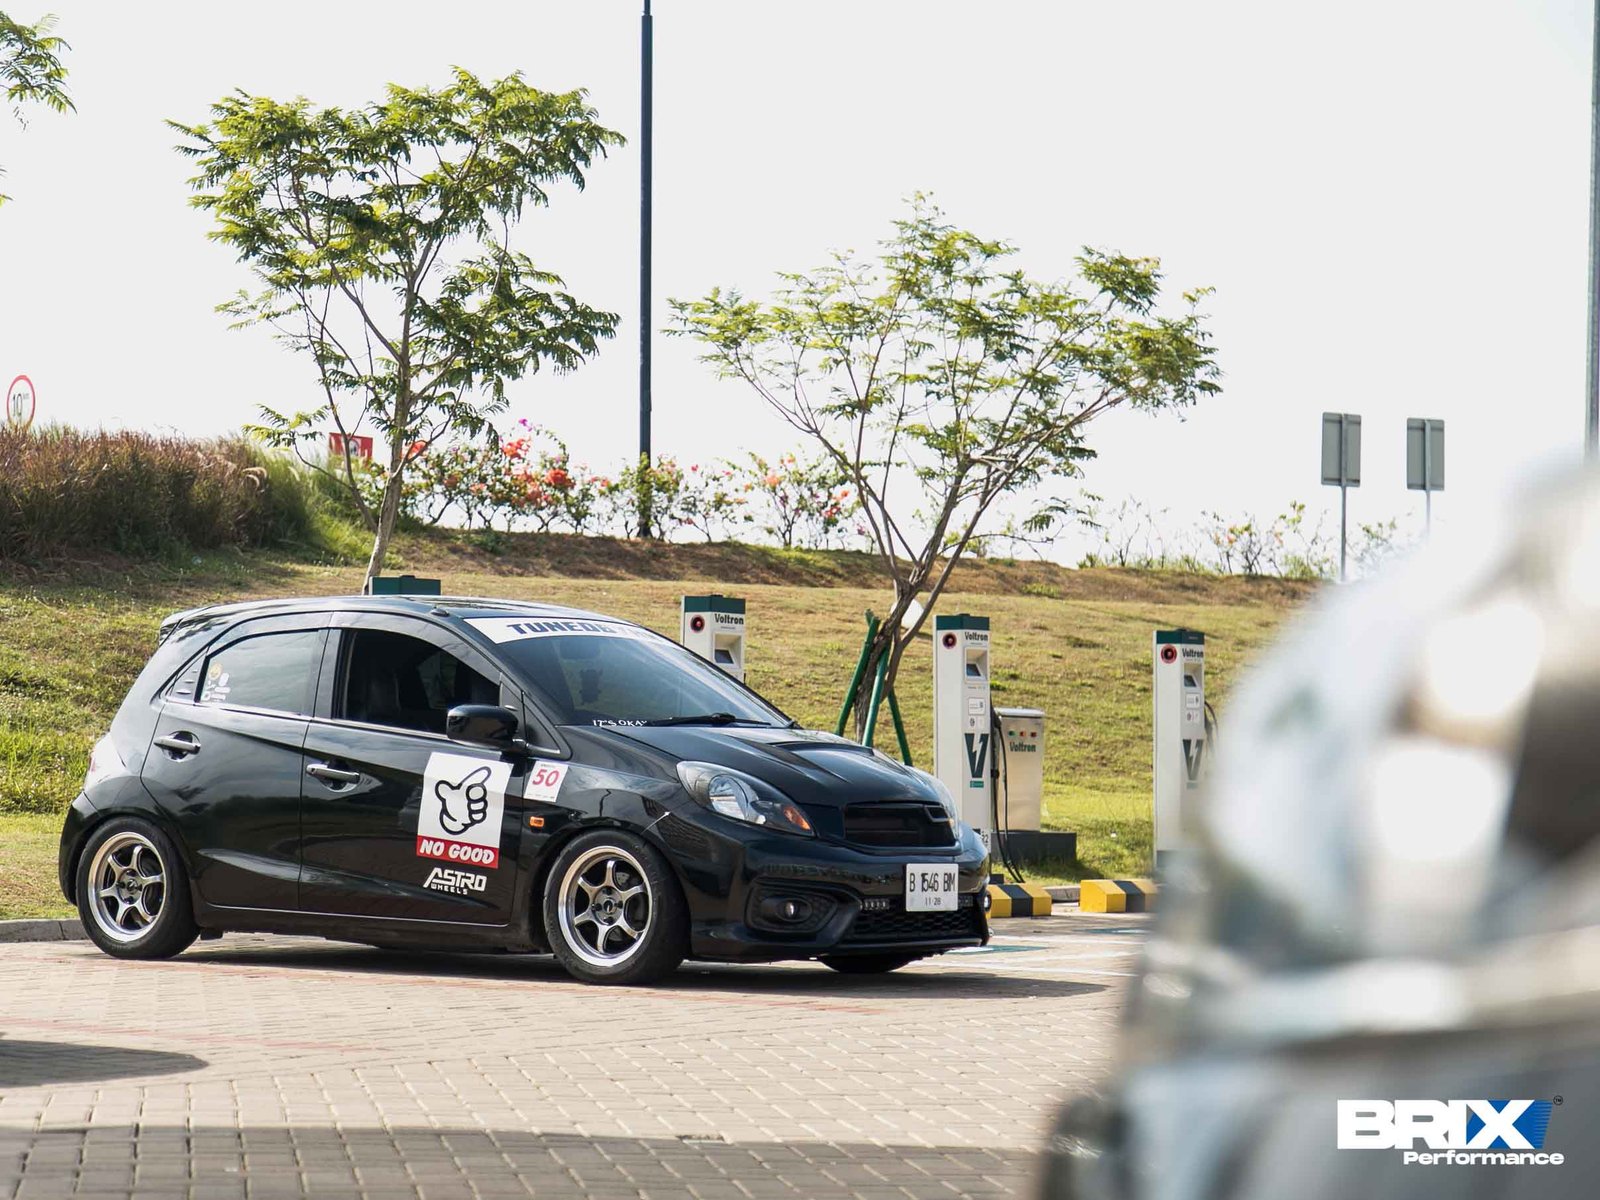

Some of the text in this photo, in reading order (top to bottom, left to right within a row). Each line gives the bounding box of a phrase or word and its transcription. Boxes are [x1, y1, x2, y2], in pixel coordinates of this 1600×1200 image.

[714, 613, 745, 625] Voltron
[964, 631, 989, 641] Voltron
[1181, 648, 1204, 658] Voltron
[618, 719, 648, 727] OKAY
[1009, 741, 1037, 752] Voltron
[532, 768, 560, 787] 50
[419, 839, 495, 865] NO GOOD
[422, 867, 488, 892] ASTRO
[909, 872, 956, 892] B 1546 BM
[430, 882, 468, 895] WHEELS
